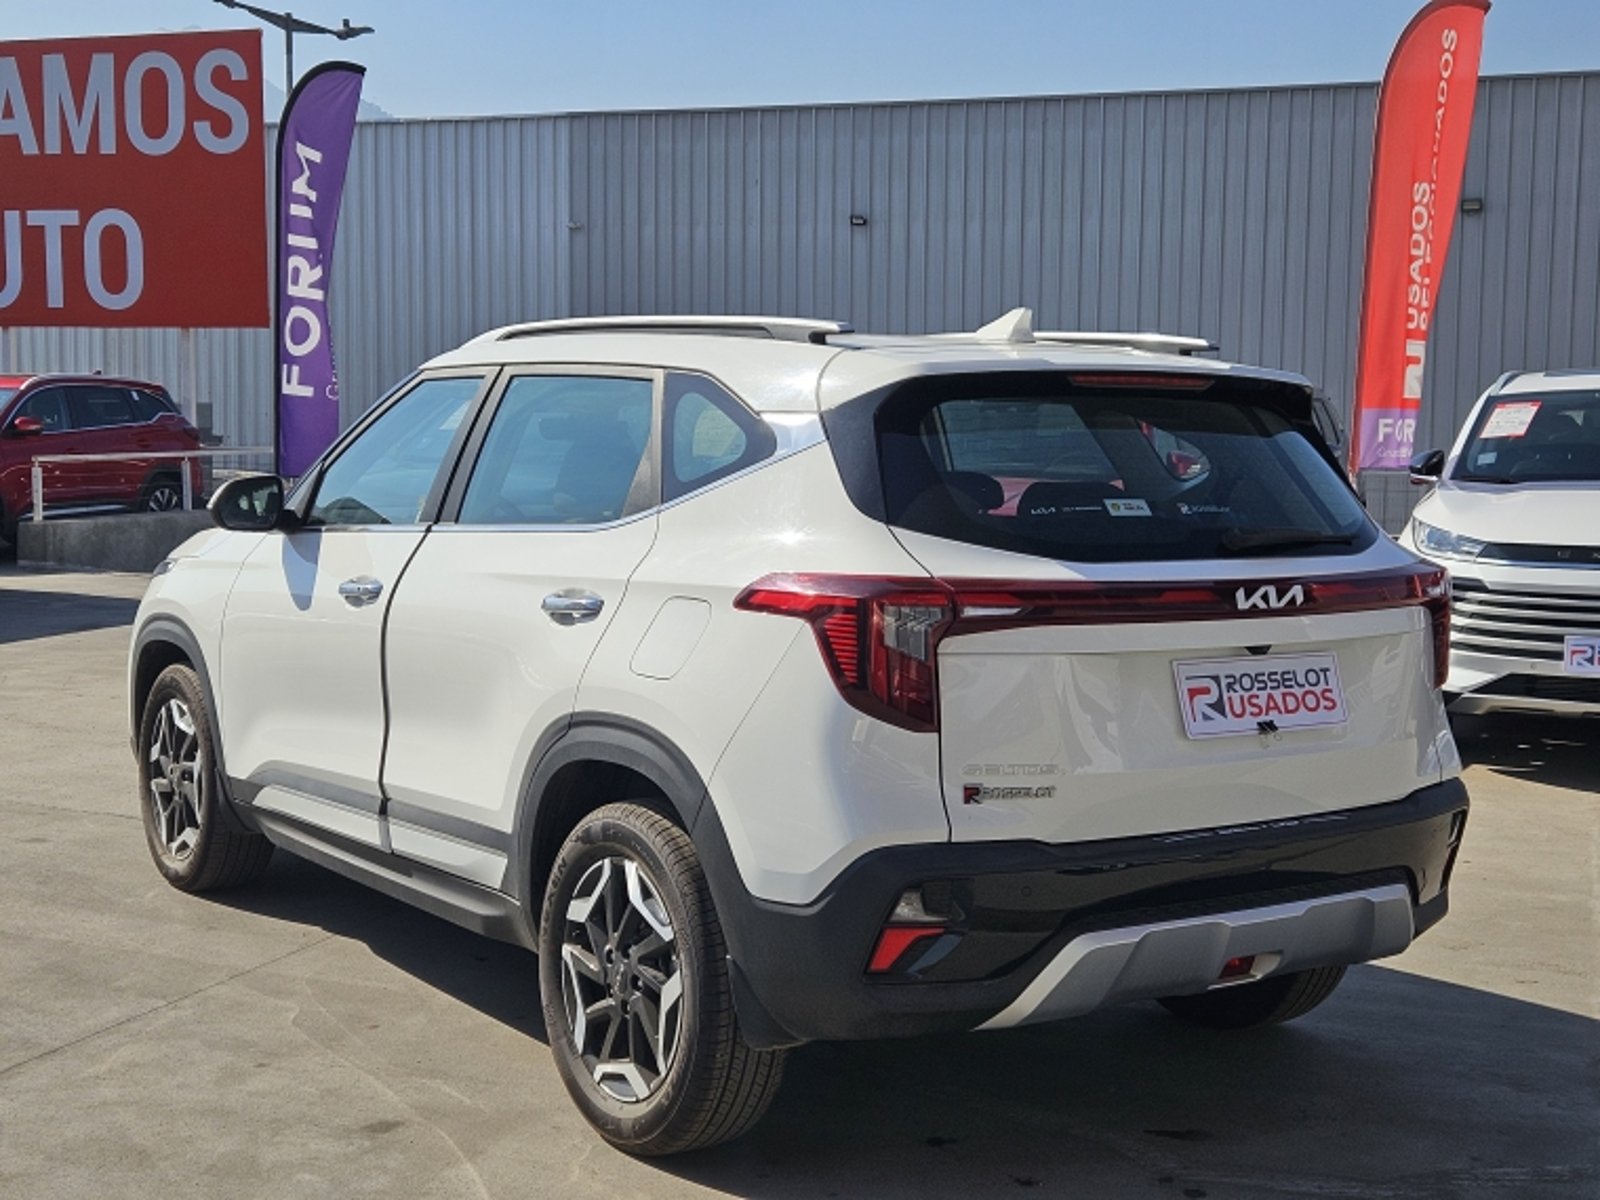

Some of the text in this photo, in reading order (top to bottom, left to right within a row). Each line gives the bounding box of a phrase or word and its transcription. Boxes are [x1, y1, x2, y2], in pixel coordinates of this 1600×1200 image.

[0, 48, 250, 156] AMOS
[1407, 181, 1430, 329] USADOS
[1235, 584, 1305, 610] KIA
[1224, 667, 1331, 692] ROSSELOT
[1228, 688, 1338, 719] USADOS
